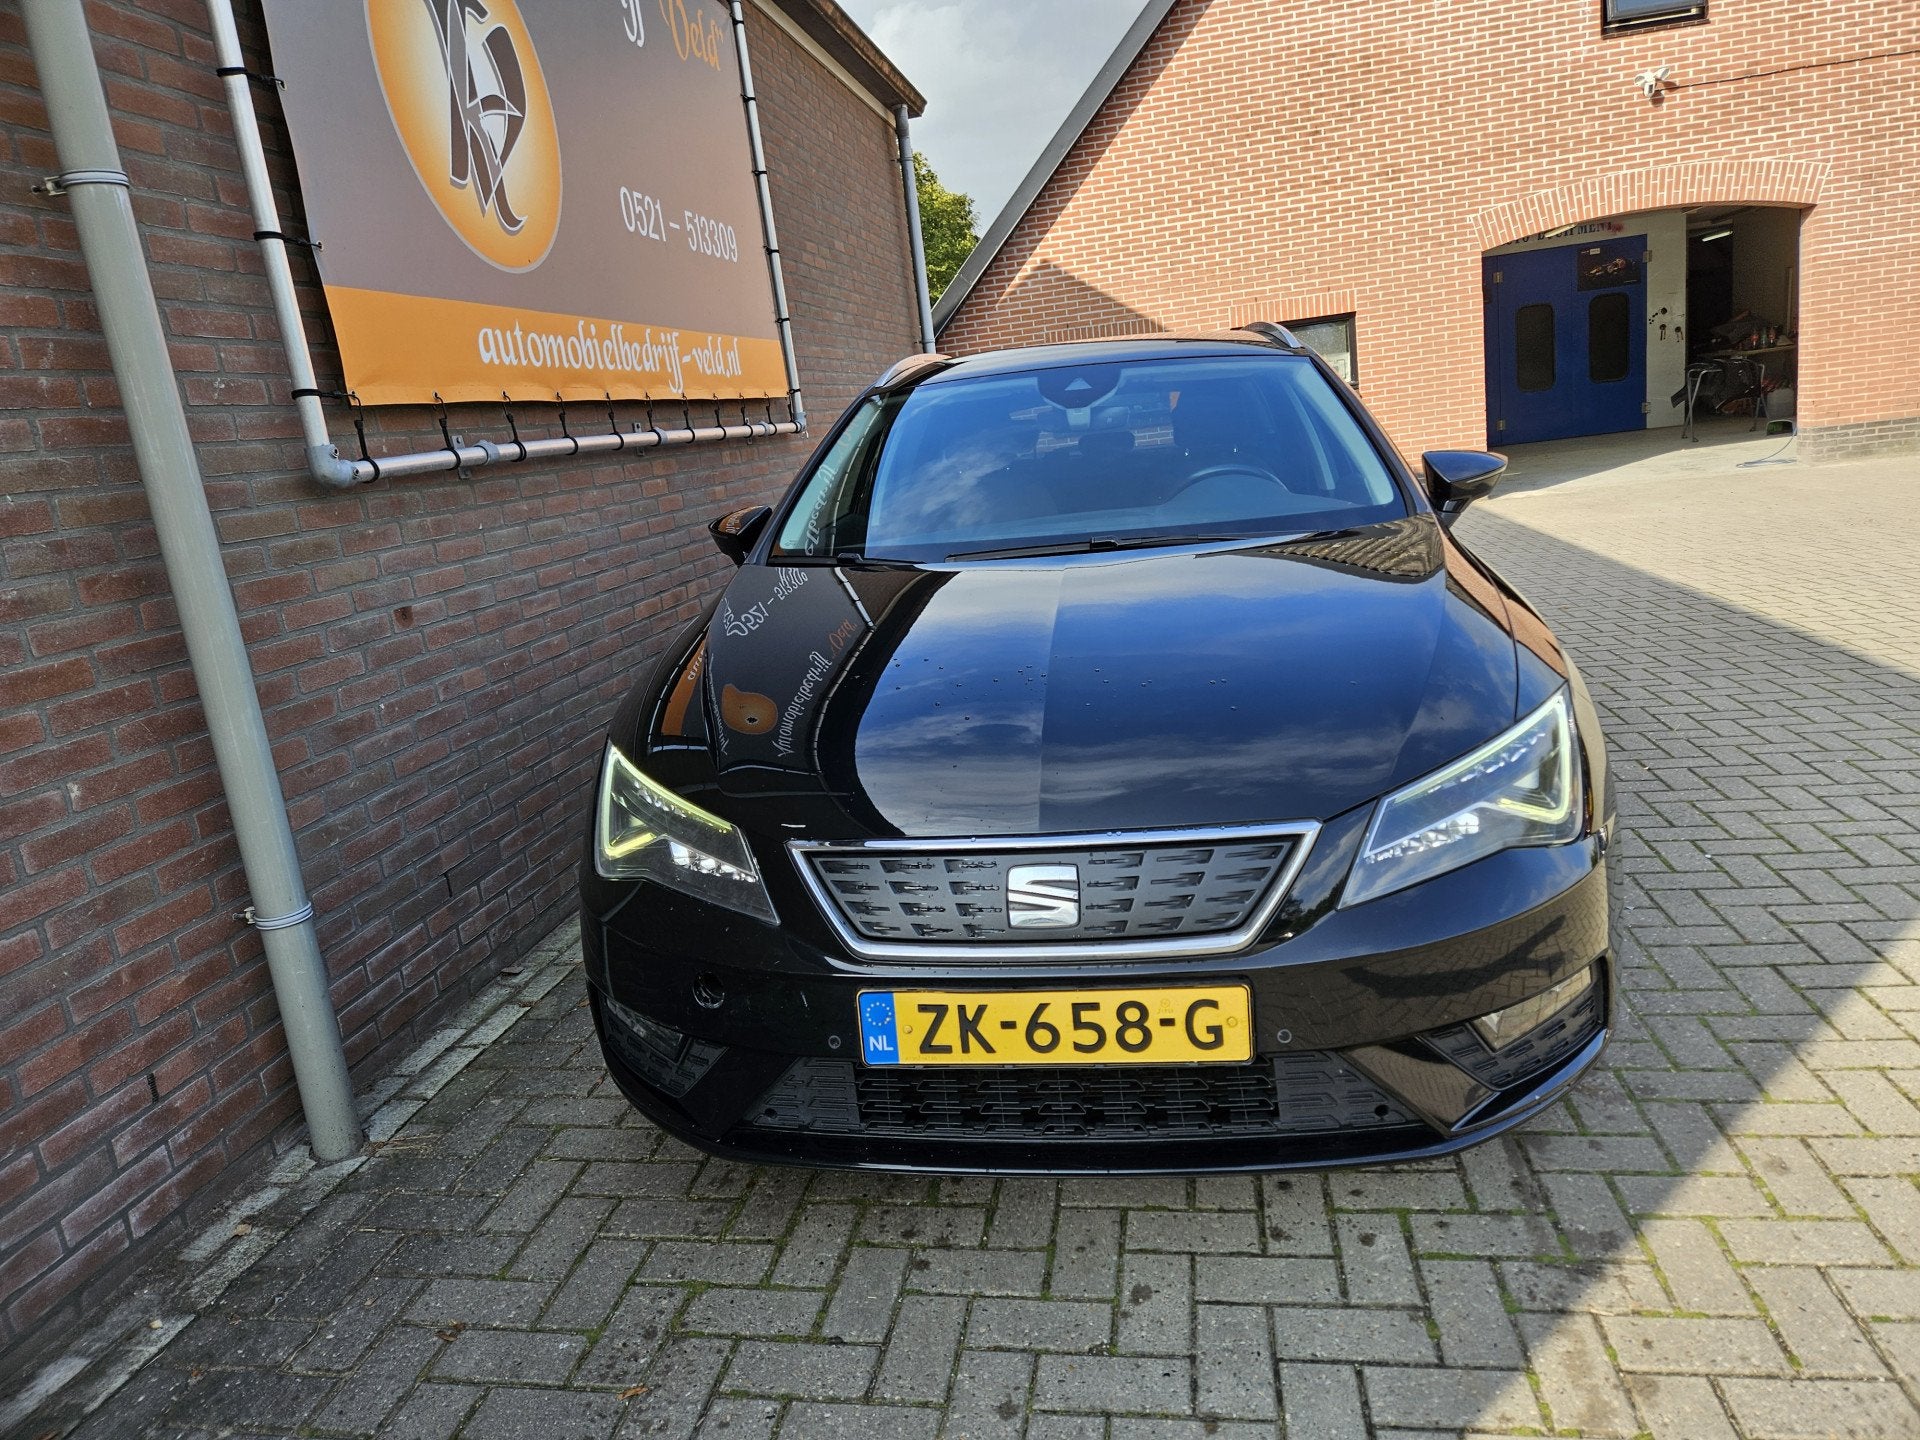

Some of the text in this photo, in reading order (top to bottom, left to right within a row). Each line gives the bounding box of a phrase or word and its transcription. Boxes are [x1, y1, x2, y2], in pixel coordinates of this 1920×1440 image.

[620, 186, 666, 241] 0521
[684, 210, 737, 263] 513309
[478, 319, 742, 393] automobielbedrijf-veld.nl
[869, 1035, 894, 1052] NL
[917, 999, 1224, 1054] ZK-658-G
